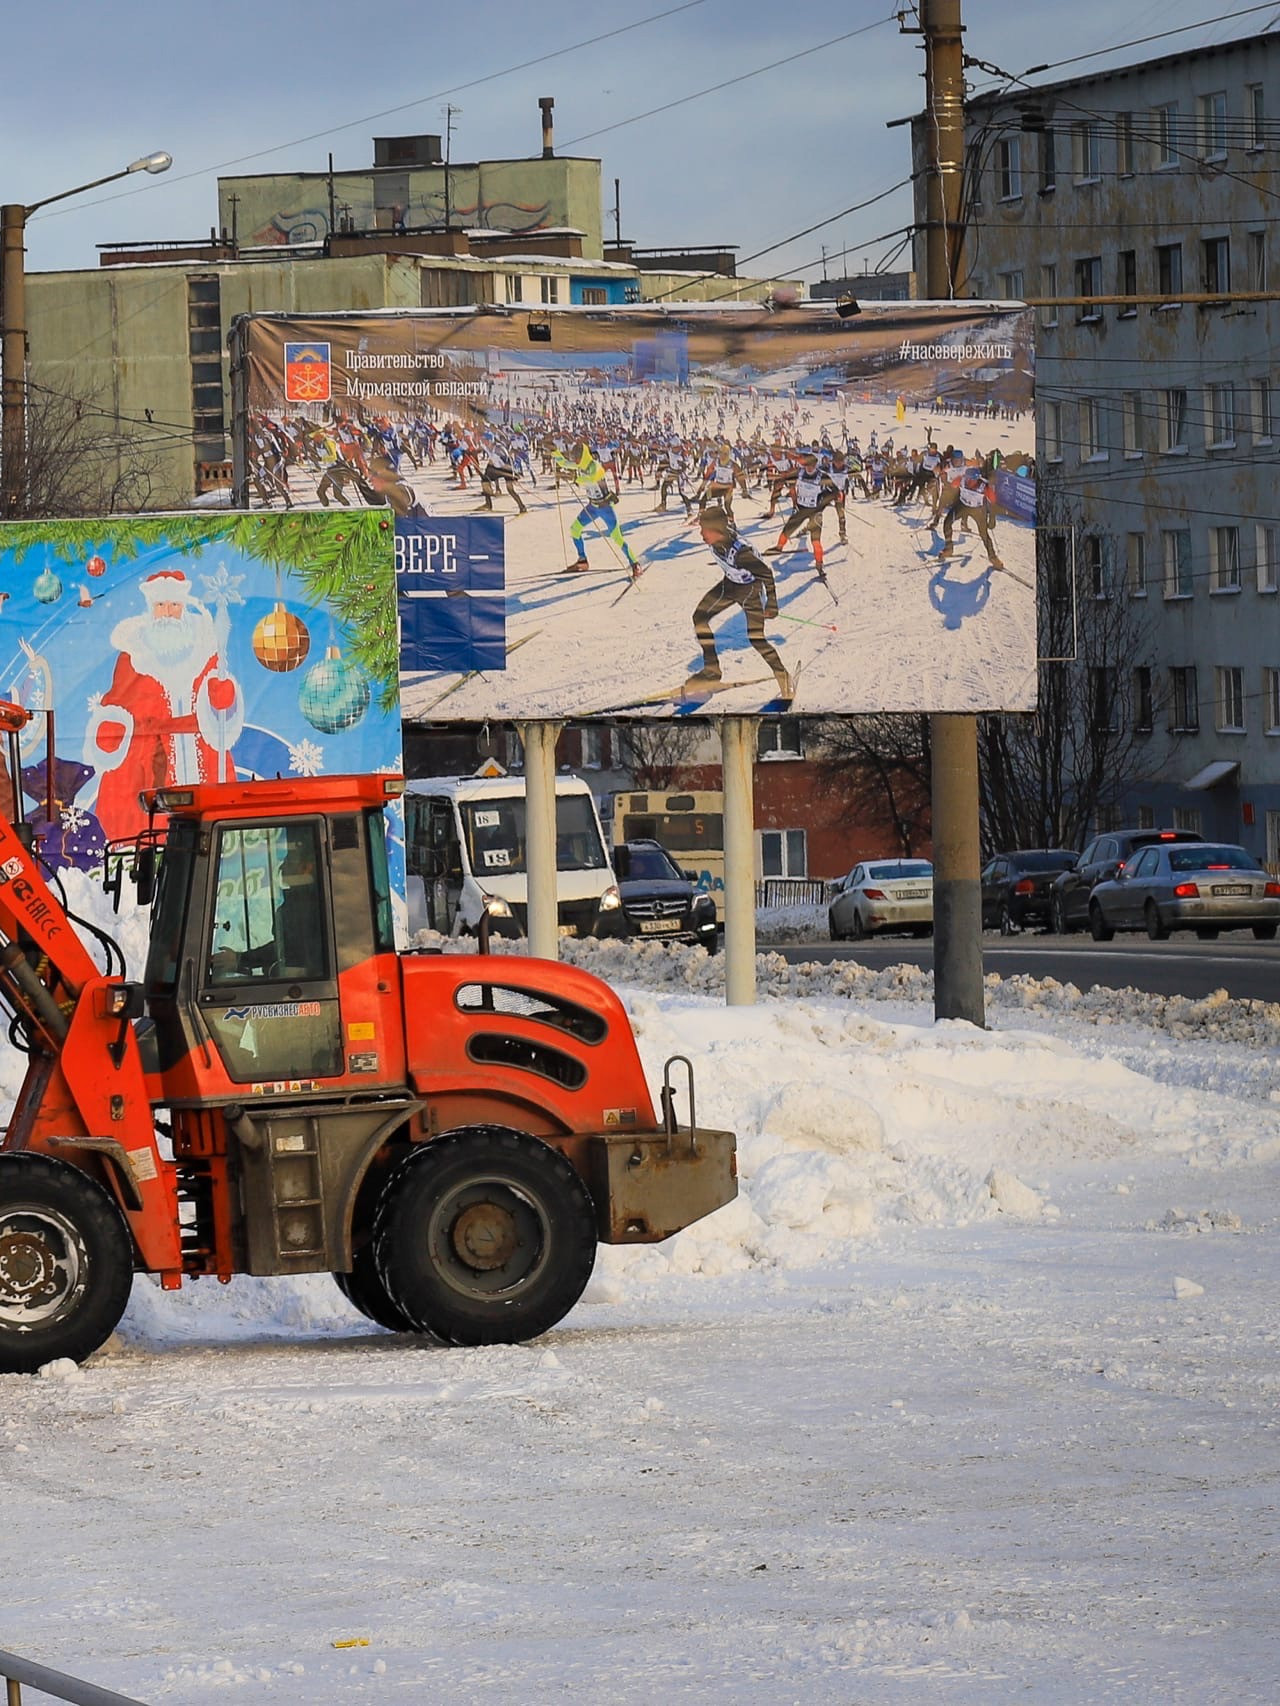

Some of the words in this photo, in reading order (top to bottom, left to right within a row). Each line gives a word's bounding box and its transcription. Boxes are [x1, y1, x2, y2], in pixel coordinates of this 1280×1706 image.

[345, 350, 444, 372] Правительство
[899, 340, 1012, 362] #насевережить
[346, 378, 433, 399] Мурманской
[435, 379, 488, 396] области
[487, 853, 507, 864] 18
